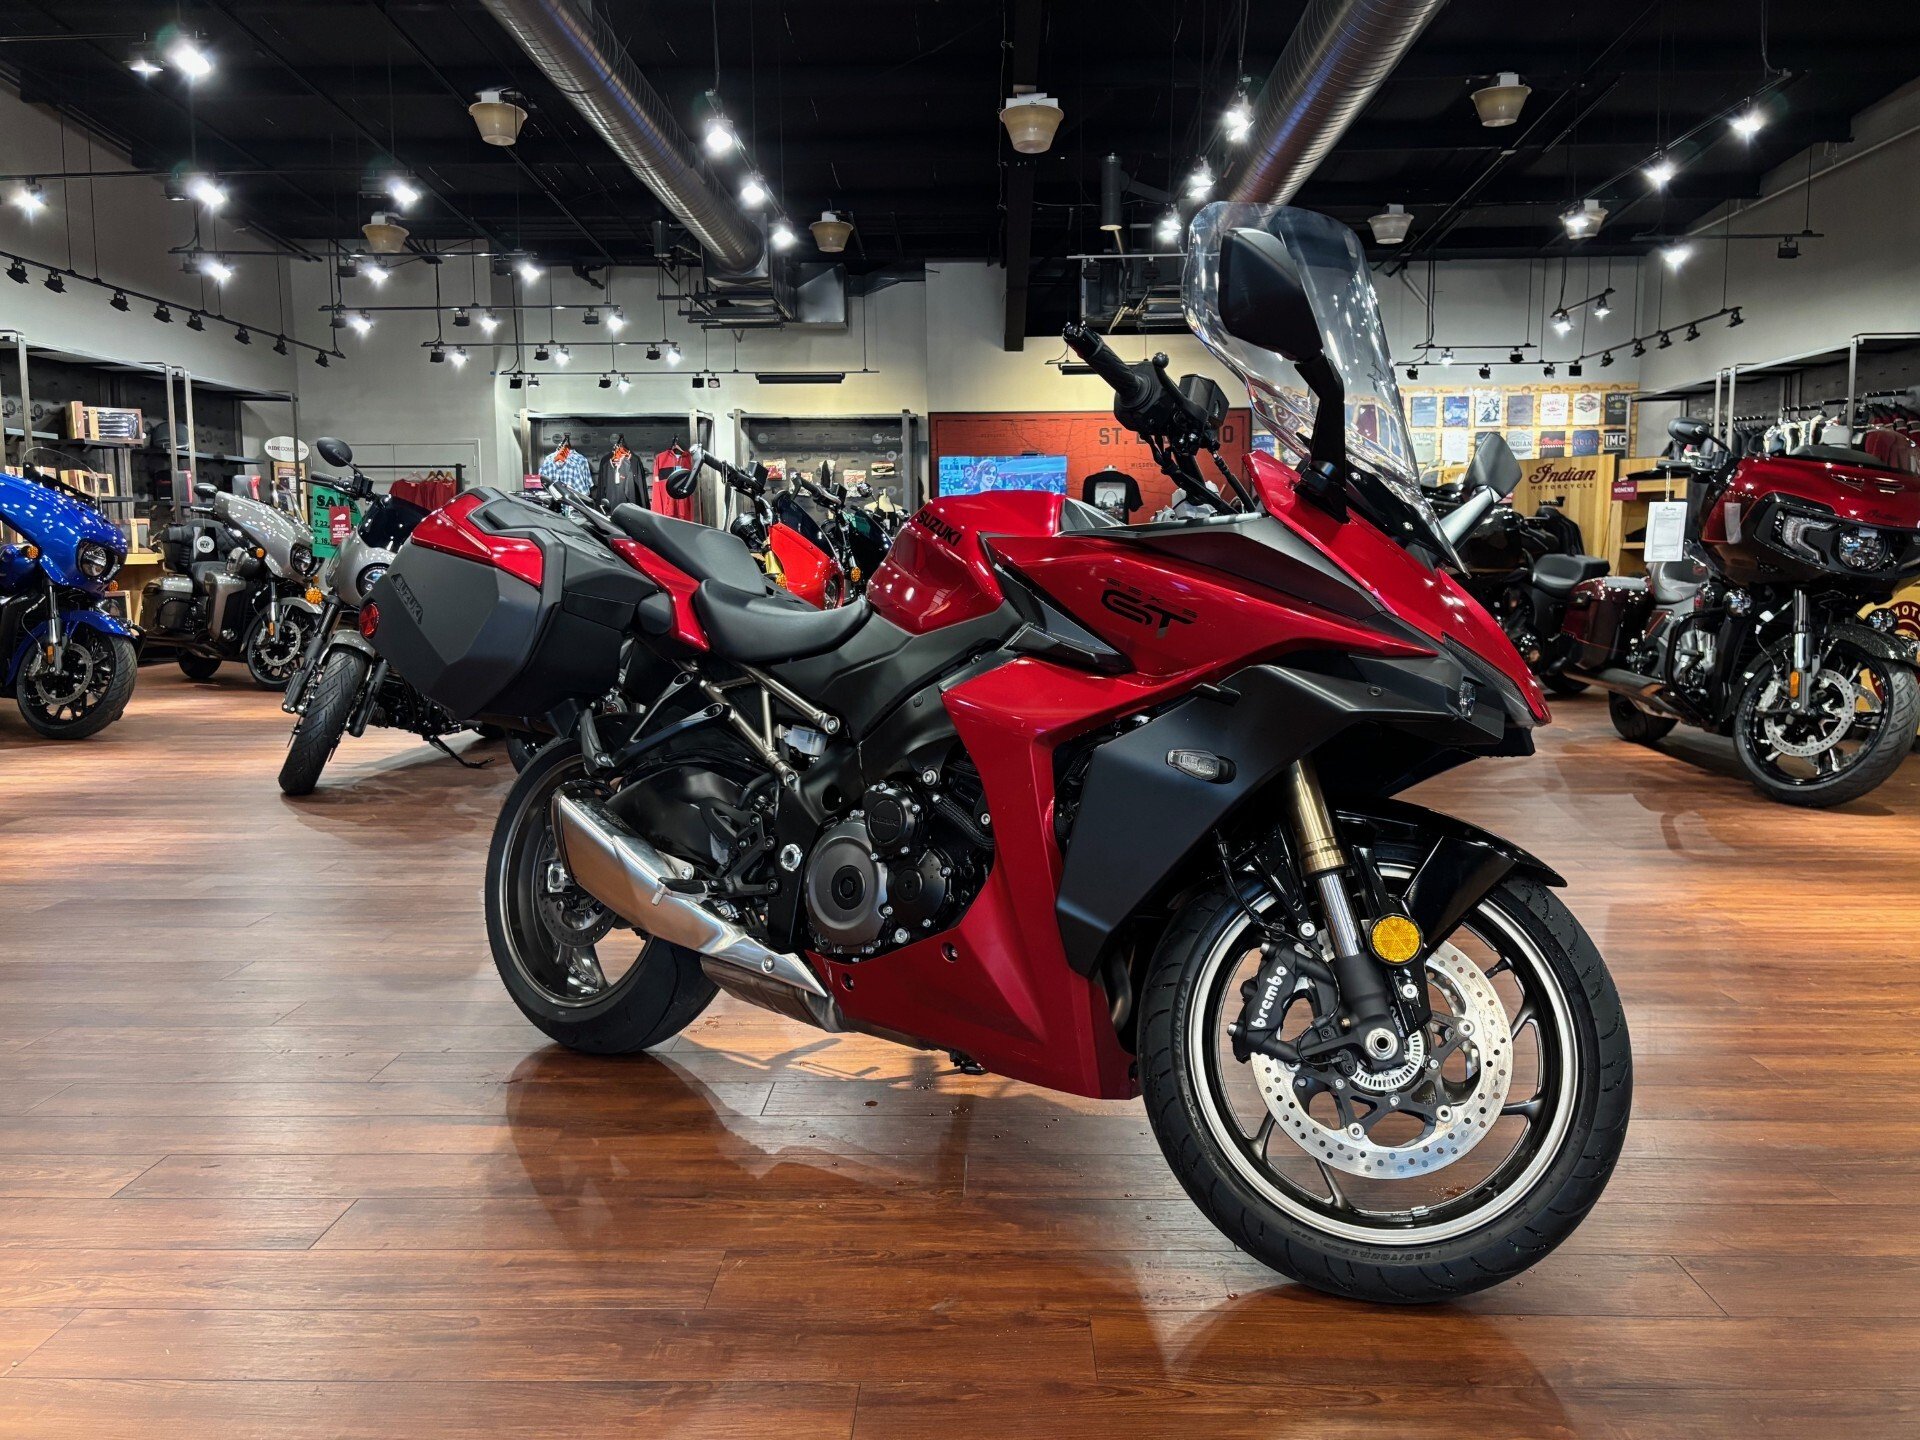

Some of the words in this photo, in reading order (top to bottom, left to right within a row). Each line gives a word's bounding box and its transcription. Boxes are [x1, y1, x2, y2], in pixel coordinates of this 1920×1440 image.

[1099, 427, 1128, 445] ST.
[1605, 435, 1627, 446] IMC
[1528, 463, 1597, 484] Indian
[917, 510, 962, 546] SUZUKI
[1251, 966, 1287, 1028] brembo
